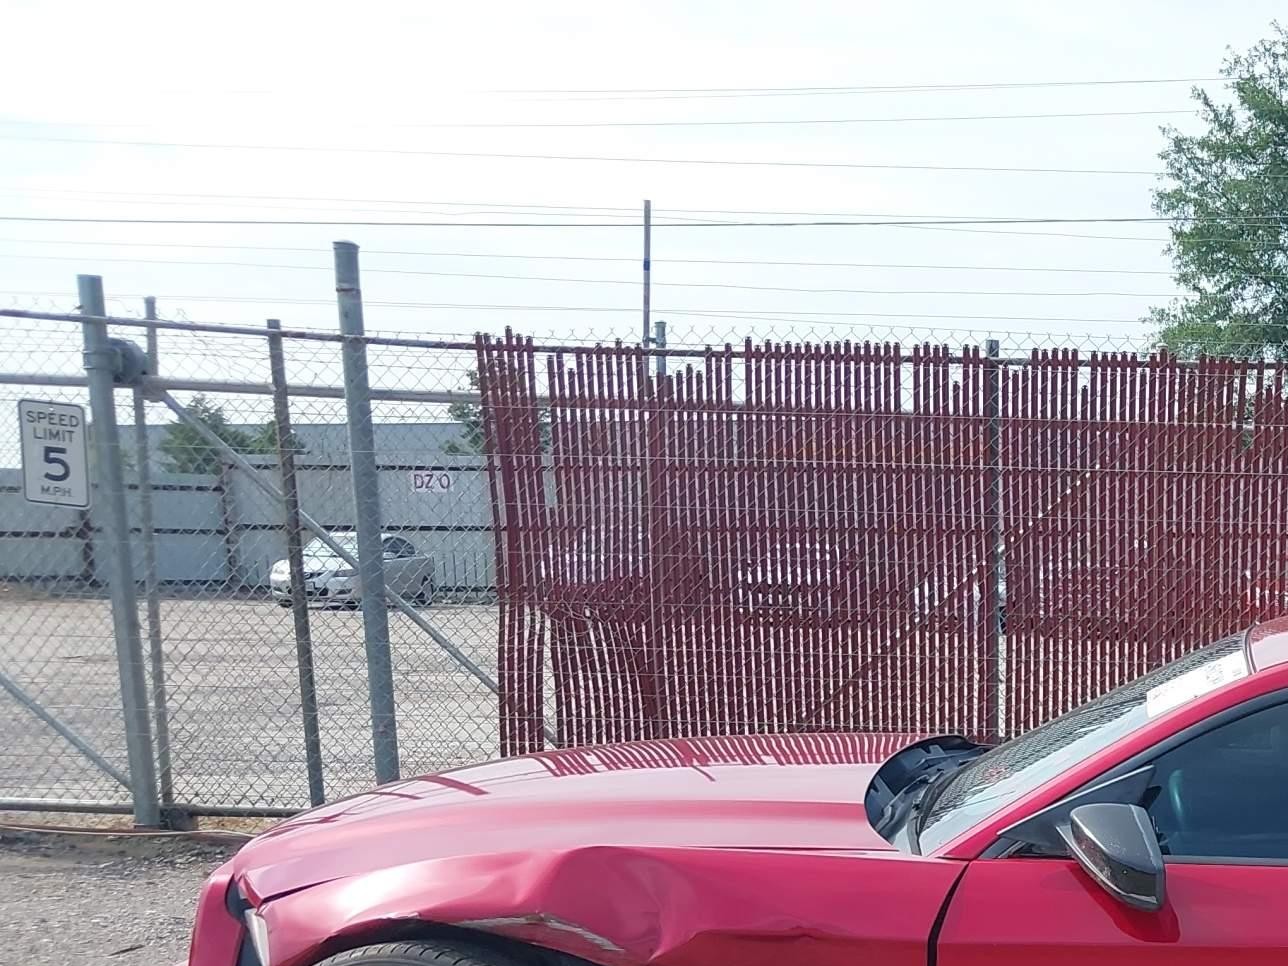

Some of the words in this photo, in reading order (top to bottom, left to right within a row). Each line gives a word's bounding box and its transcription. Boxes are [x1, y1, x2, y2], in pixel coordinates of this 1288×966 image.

[26, 410, 80, 428] SPEED
[33, 426, 75, 443] LIMIT
[43, 446, 71, 481] 5
